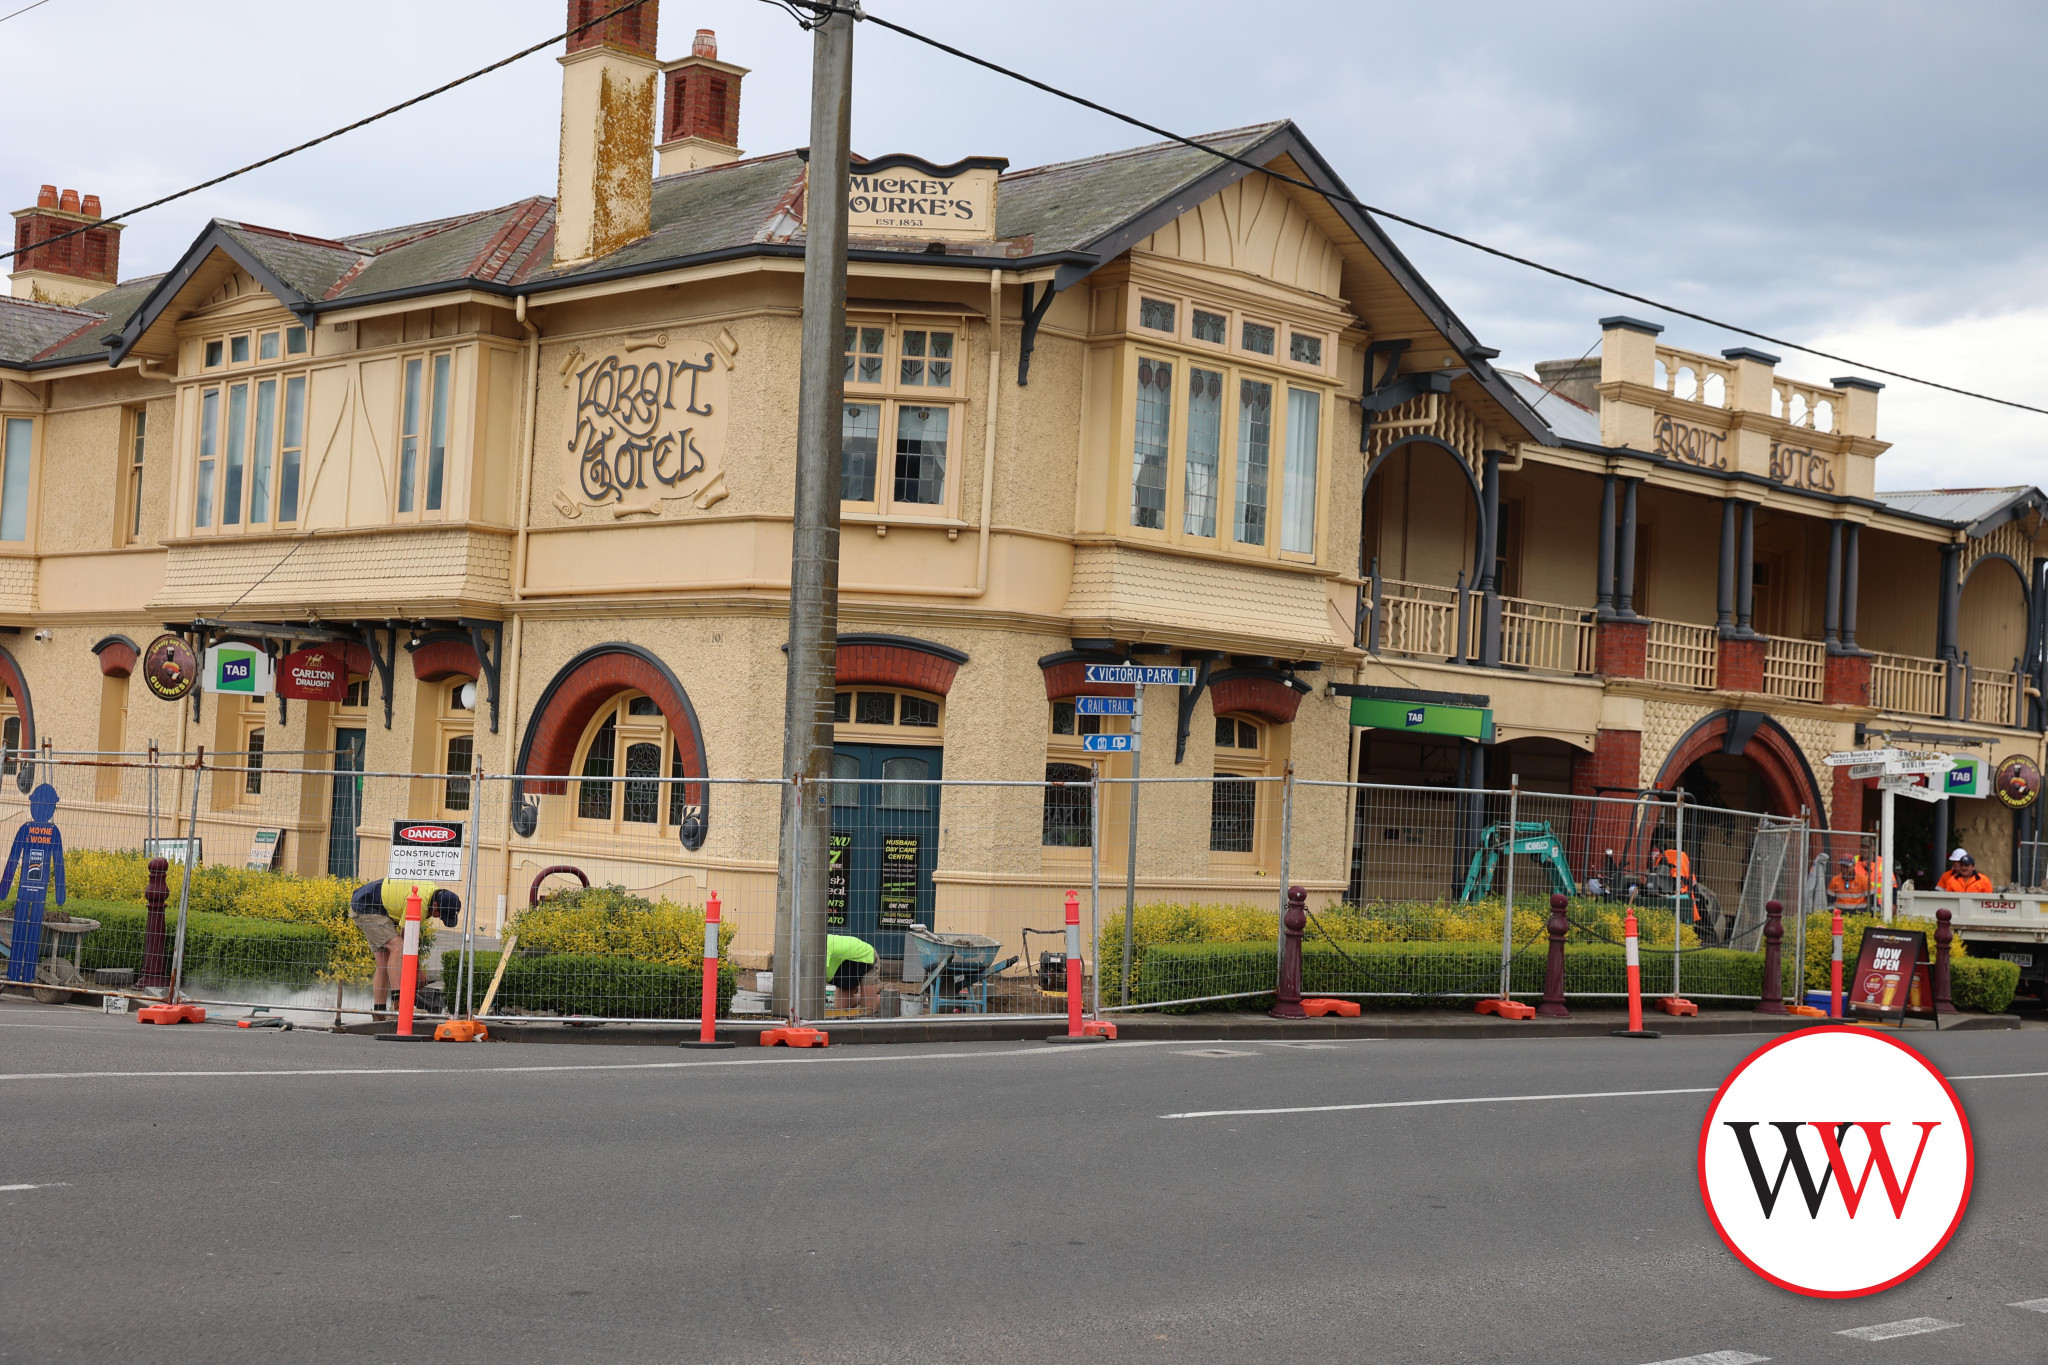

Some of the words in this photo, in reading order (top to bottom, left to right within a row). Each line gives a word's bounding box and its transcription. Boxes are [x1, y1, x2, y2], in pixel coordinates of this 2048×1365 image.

[849, 176, 955, 196] MICKEY
[849, 196, 974, 220] OURKE'S
[900, 219, 924, 227] 1853
[568, 352, 715, 452] KOROIT
[579, 416, 705, 502] HOTEL
[225, 664, 248, 677] TAB
[291, 667, 335, 681] CARLTON
[1099, 667, 1144, 682] VICTORIA
[1146, 668, 1174, 683] PARK
[150, 675, 189, 695] GUINNESS
[295, 678, 331, 688] DRAUGHT
[1087, 698, 1106, 713] RAIL
[1108, 699, 1130, 713] TRAIL
[1407, 711, 1423, 723] TAB
[1951, 771, 1971, 782] TAB
[2000, 789, 2035, 806] GUINNESS
[29, 827, 52, 835] MOYNE
[407, 829, 449, 839] DANGER
[30, 836, 51, 844] WORK
[830, 836, 851, 846] ENU
[1525, 840, 1549, 851] KOBELCO
[393, 849, 460, 859] CONSTRUCTION
[409, 868, 427, 877] NOT
[429, 869, 456, 877] ENTER
[1981, 901, 2017, 910] ISUZU
[1875, 947, 1902, 960] NOW
[1872, 958, 1900, 971] OPEN
